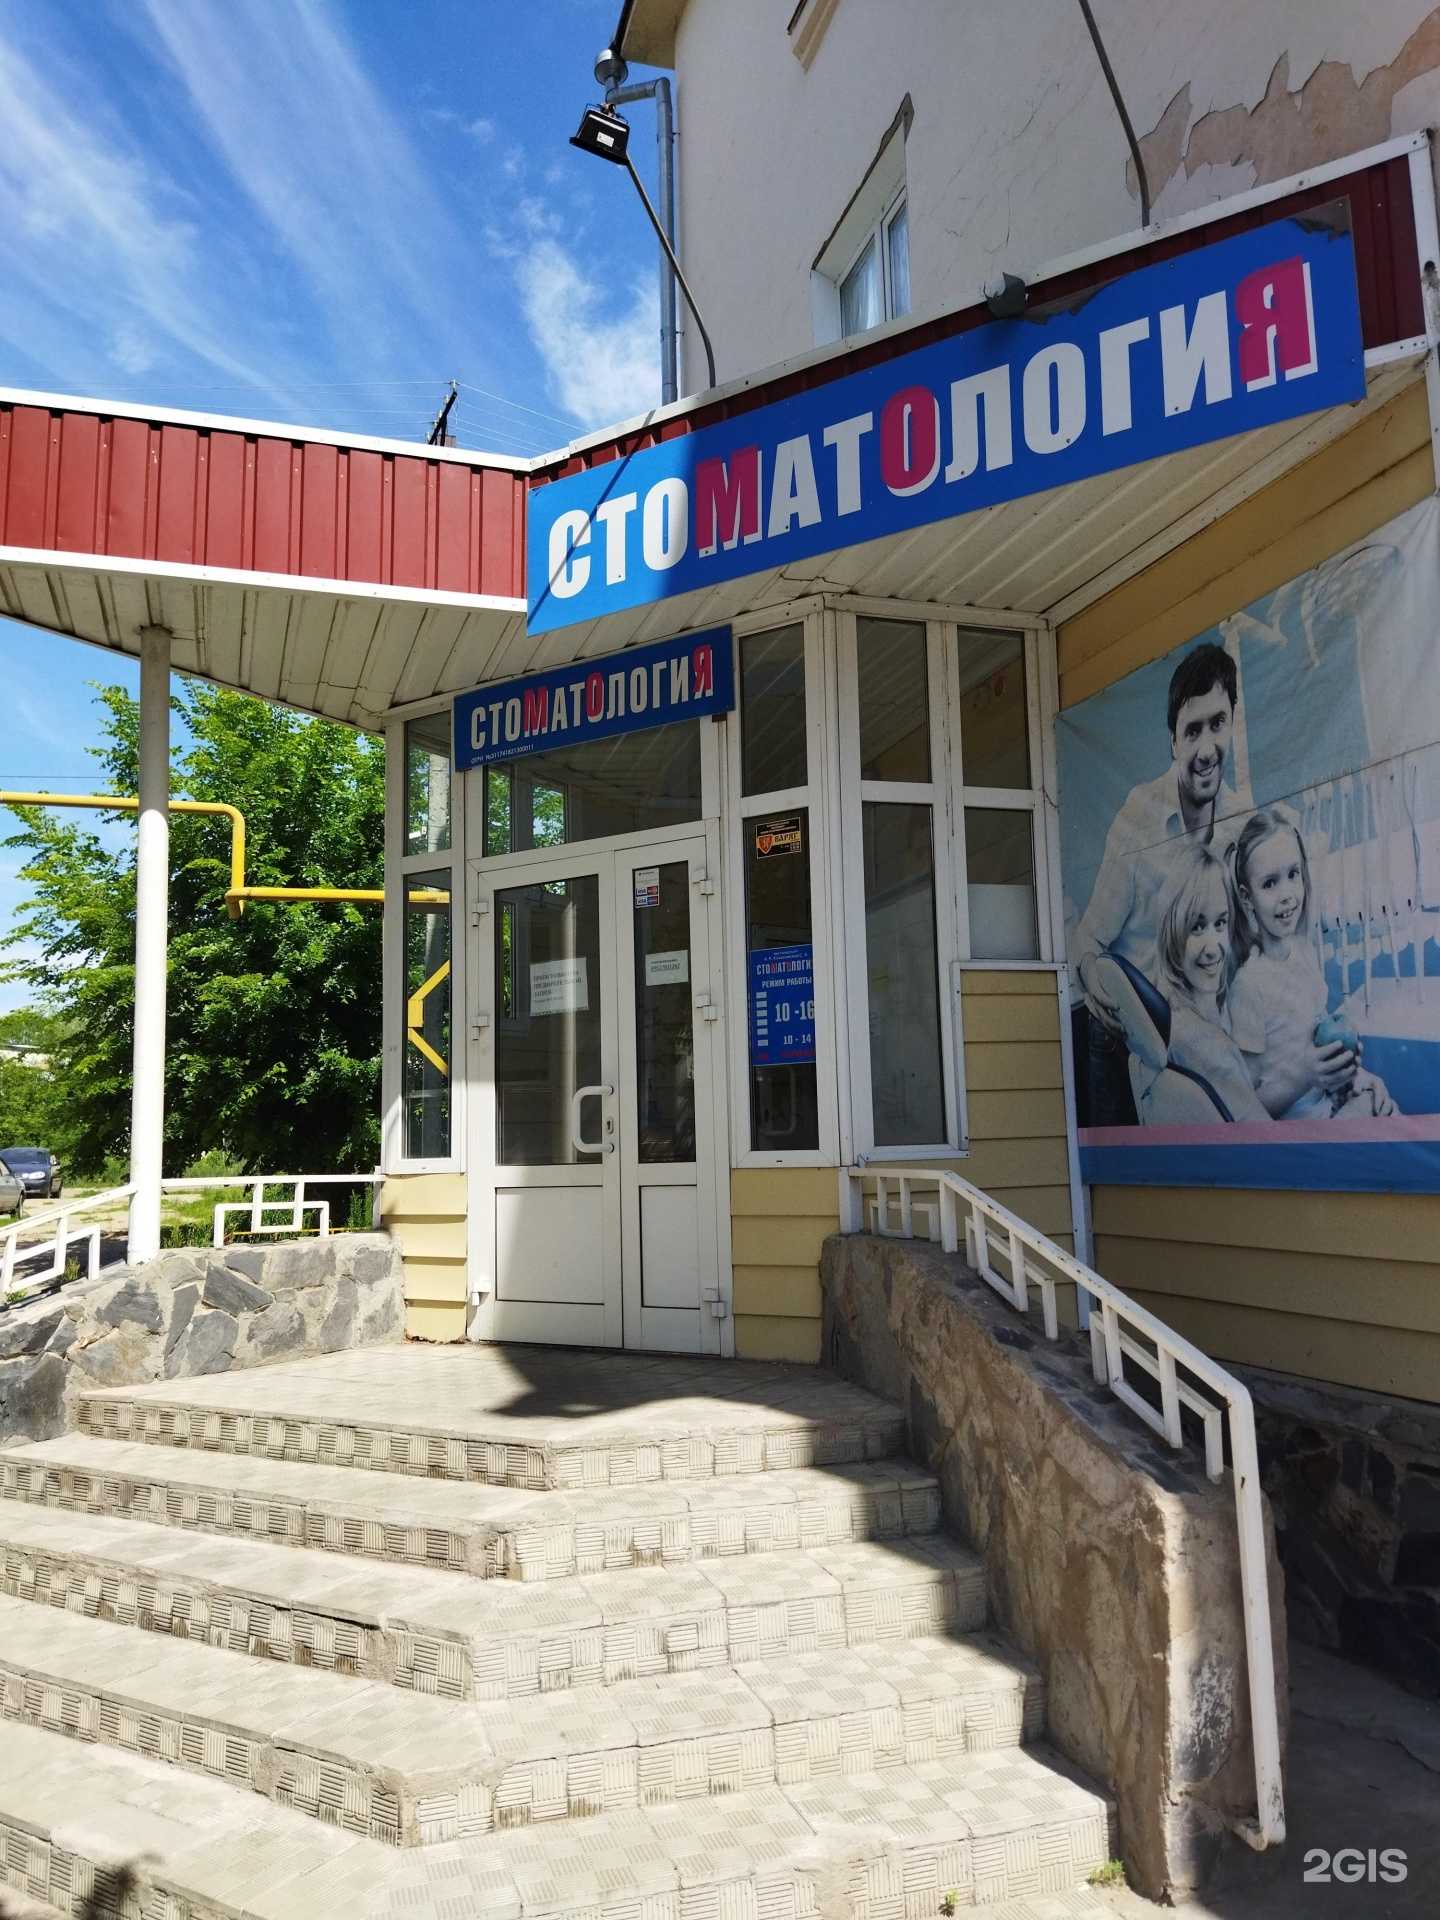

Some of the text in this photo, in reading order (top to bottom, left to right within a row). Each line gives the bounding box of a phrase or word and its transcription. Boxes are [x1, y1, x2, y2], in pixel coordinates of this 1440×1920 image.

[549, 256, 1317, 599] СТОМАТОЛОГИЯ
[470, 645, 714, 750] СТОМАТОЛОГИЯ
[756, 959, 813, 976] СТОМАТОЛОГИ
[762, 979, 785, 989] РЕЖИМ
[775, 1002, 791, 1023] 10
